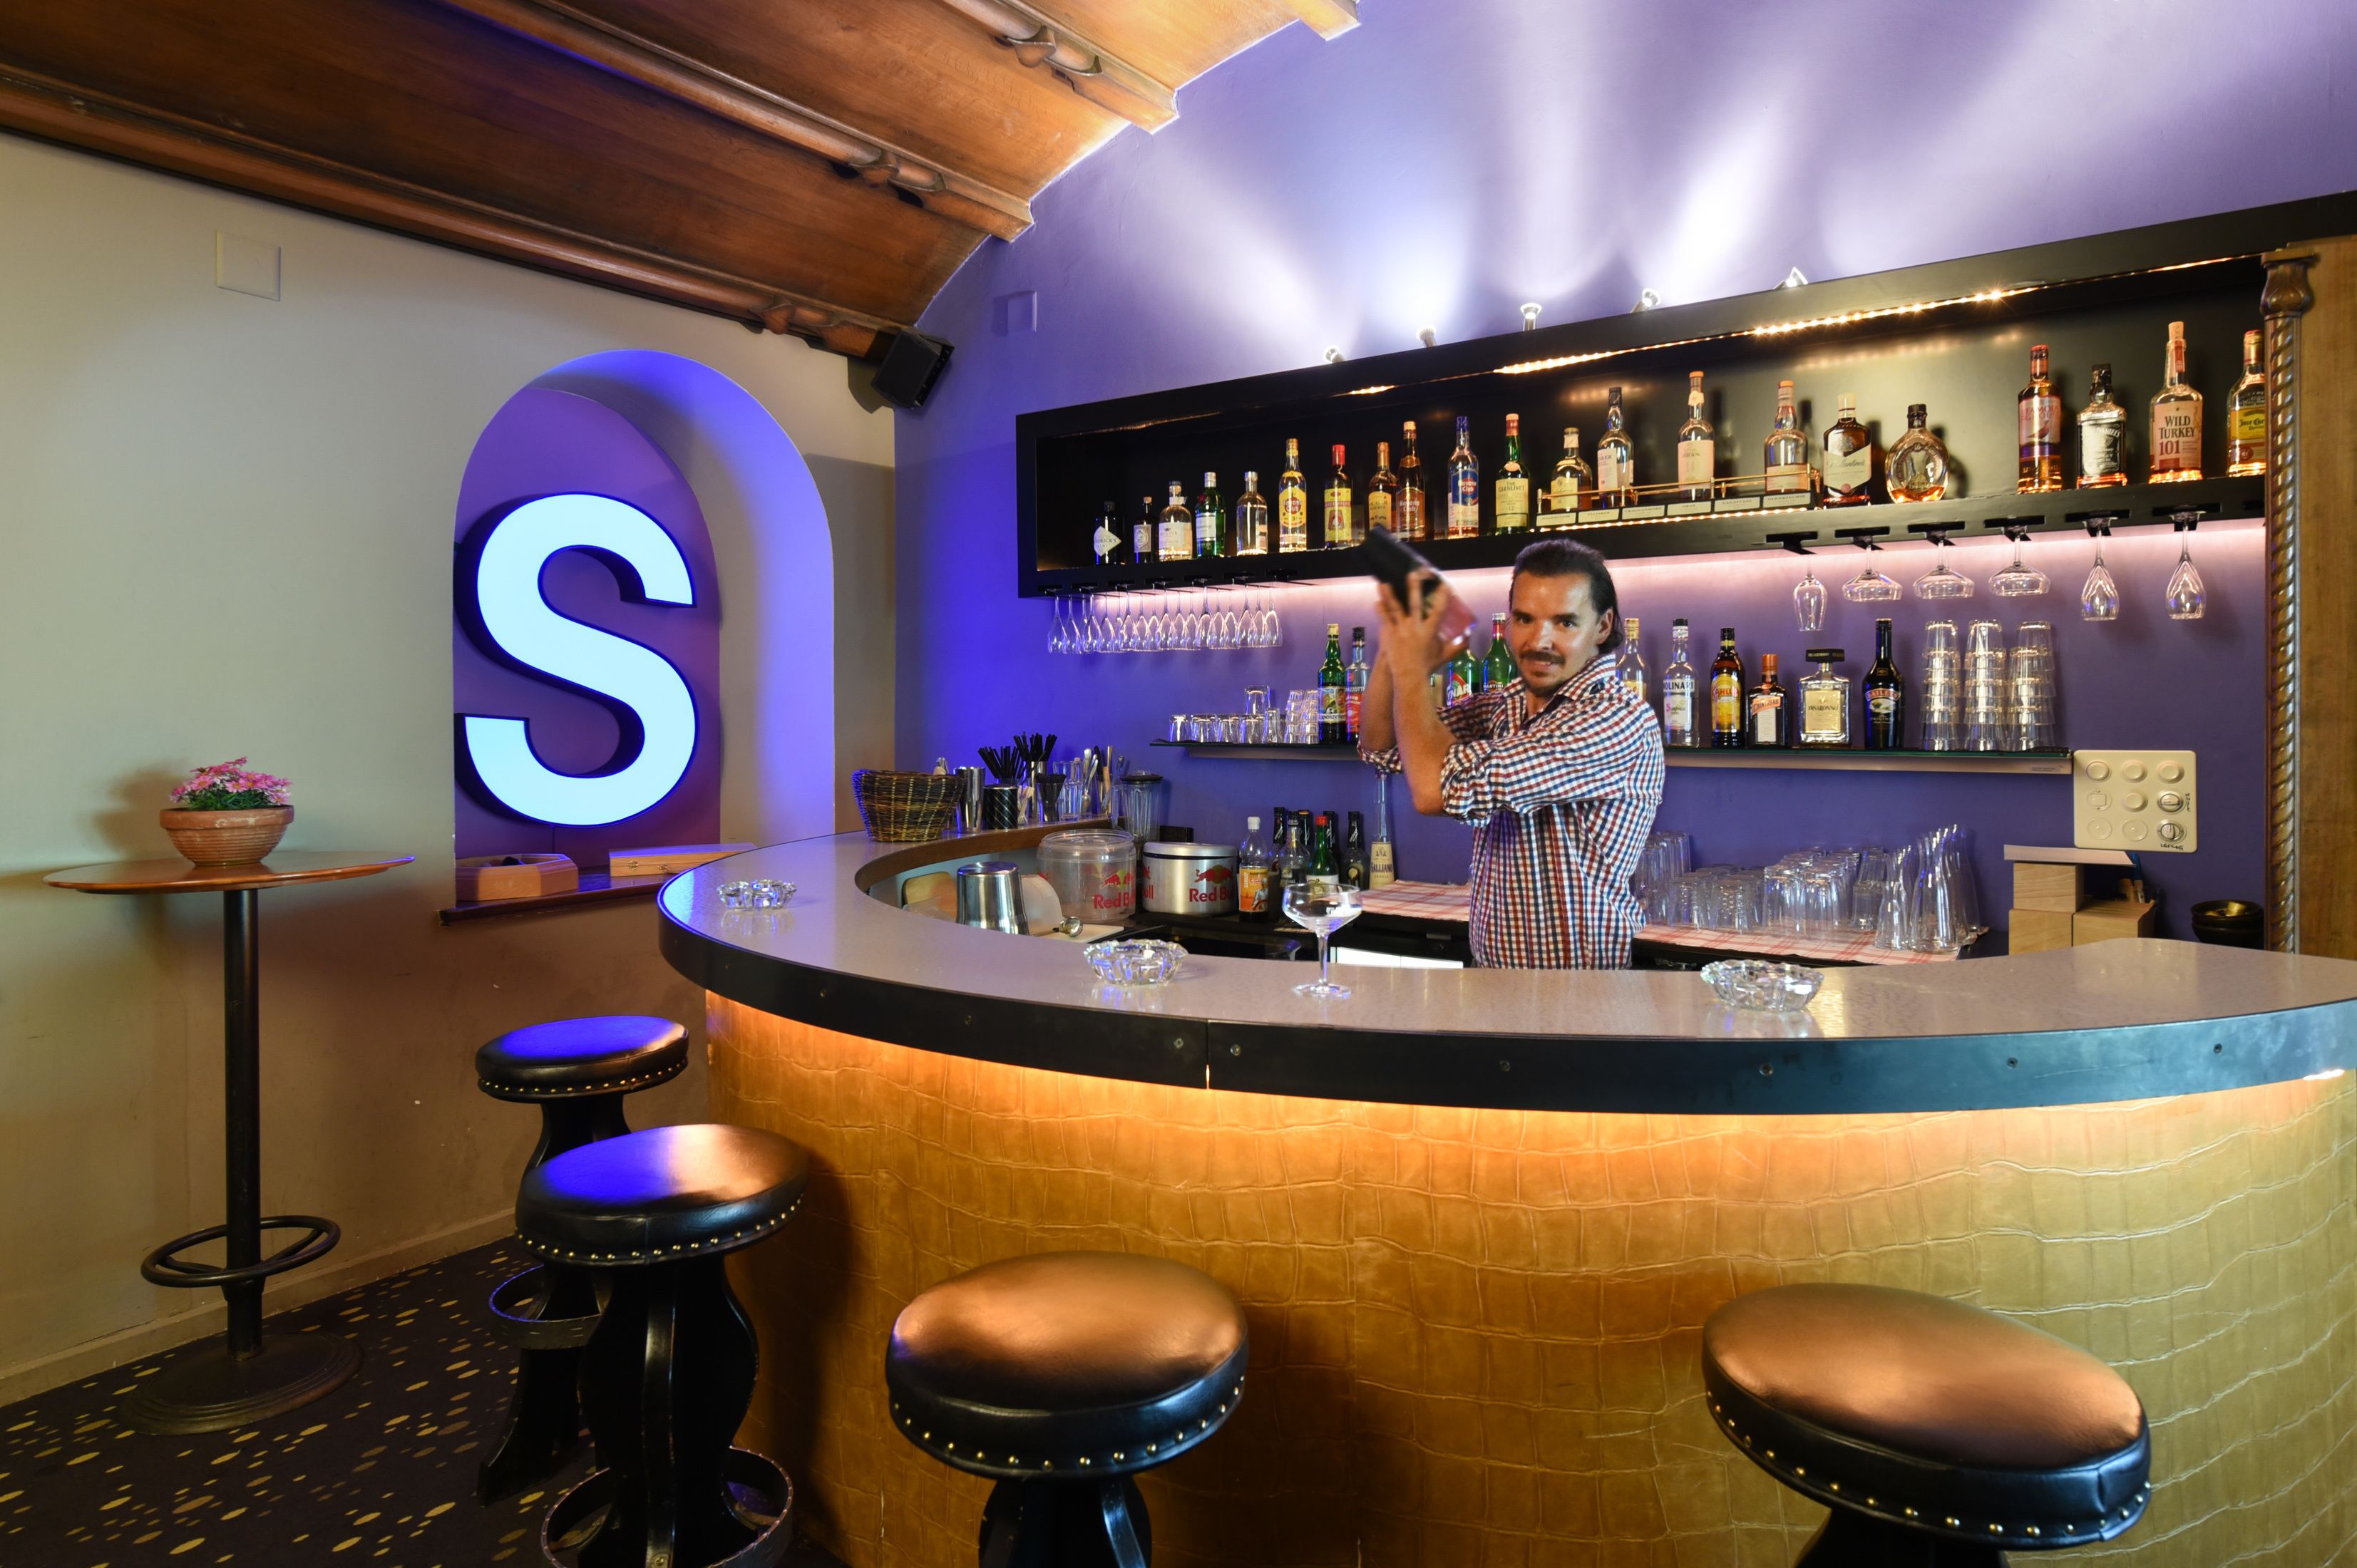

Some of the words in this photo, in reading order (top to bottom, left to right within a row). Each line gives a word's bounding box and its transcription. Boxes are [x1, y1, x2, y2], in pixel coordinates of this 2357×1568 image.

[2165, 416, 2191, 427] WILD
[2239, 419, 2252, 428] Jose
[2159, 427, 2195, 439] TURKEY
[2159, 440, 2180, 455] 101
[463, 492, 698, 827] S
[1663, 681, 1694, 690] OLINARI
[1866, 689, 1899, 700] BAILEYS
[1370, 862, 1393, 873] GALLIANO
[1093, 892, 1121, 909] Red
[1188, 888, 1217, 902] Red
